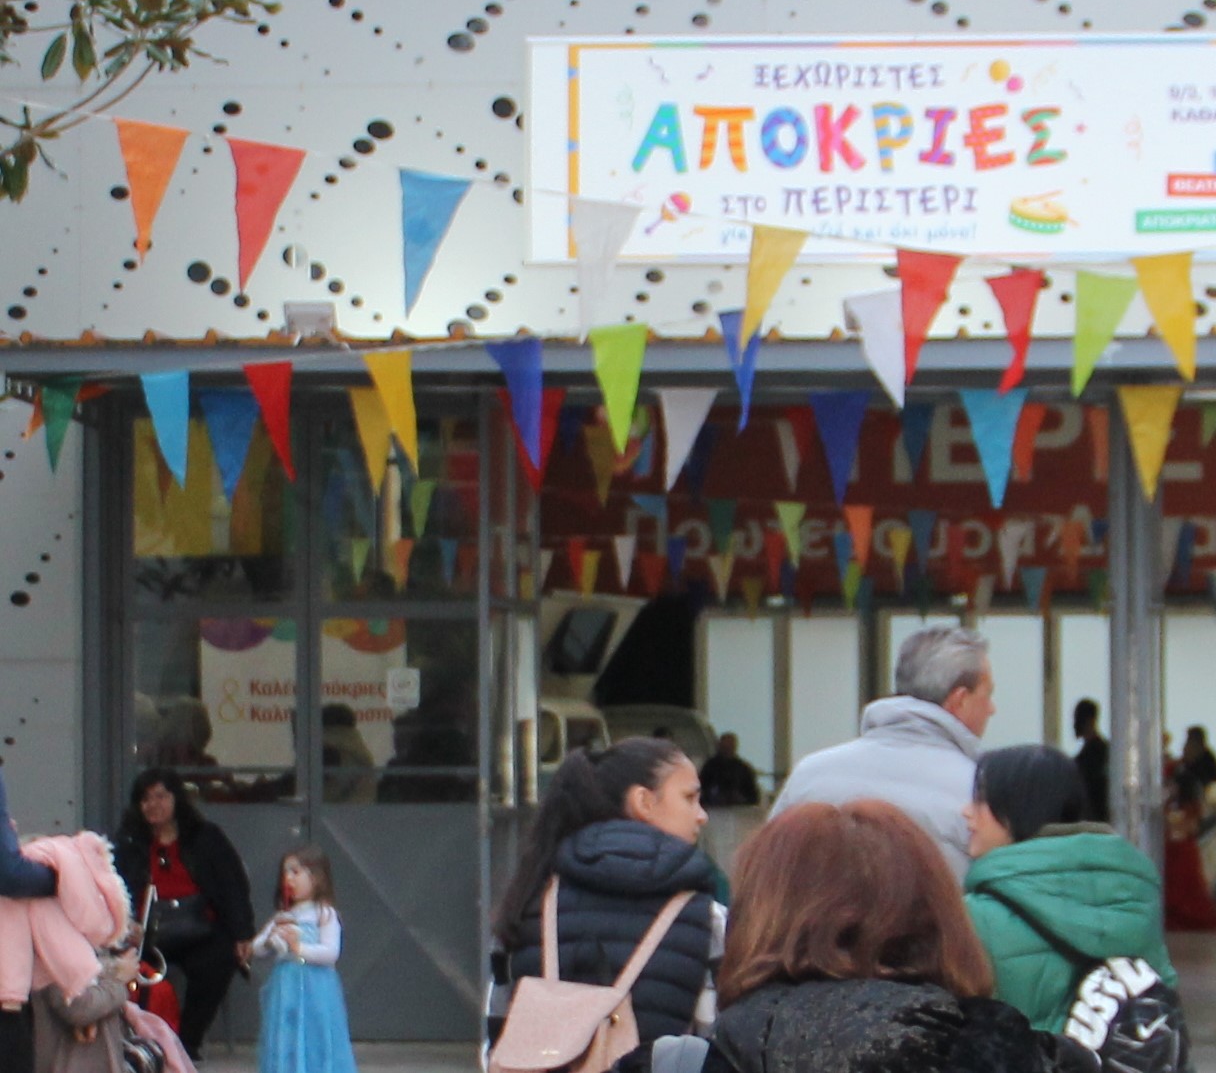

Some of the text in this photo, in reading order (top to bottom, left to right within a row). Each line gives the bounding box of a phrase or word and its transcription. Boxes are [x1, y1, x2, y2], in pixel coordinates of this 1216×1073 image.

[754, 62, 946, 90] ΞΕΧΩΡΙΣΤΕΣ
[631, 102, 1068, 173] ΑΠΟΚΡΙΕΣ
[721, 184, 979, 218] ΣΤΟ ΠΕΡΙΣΤΕΡΙ
